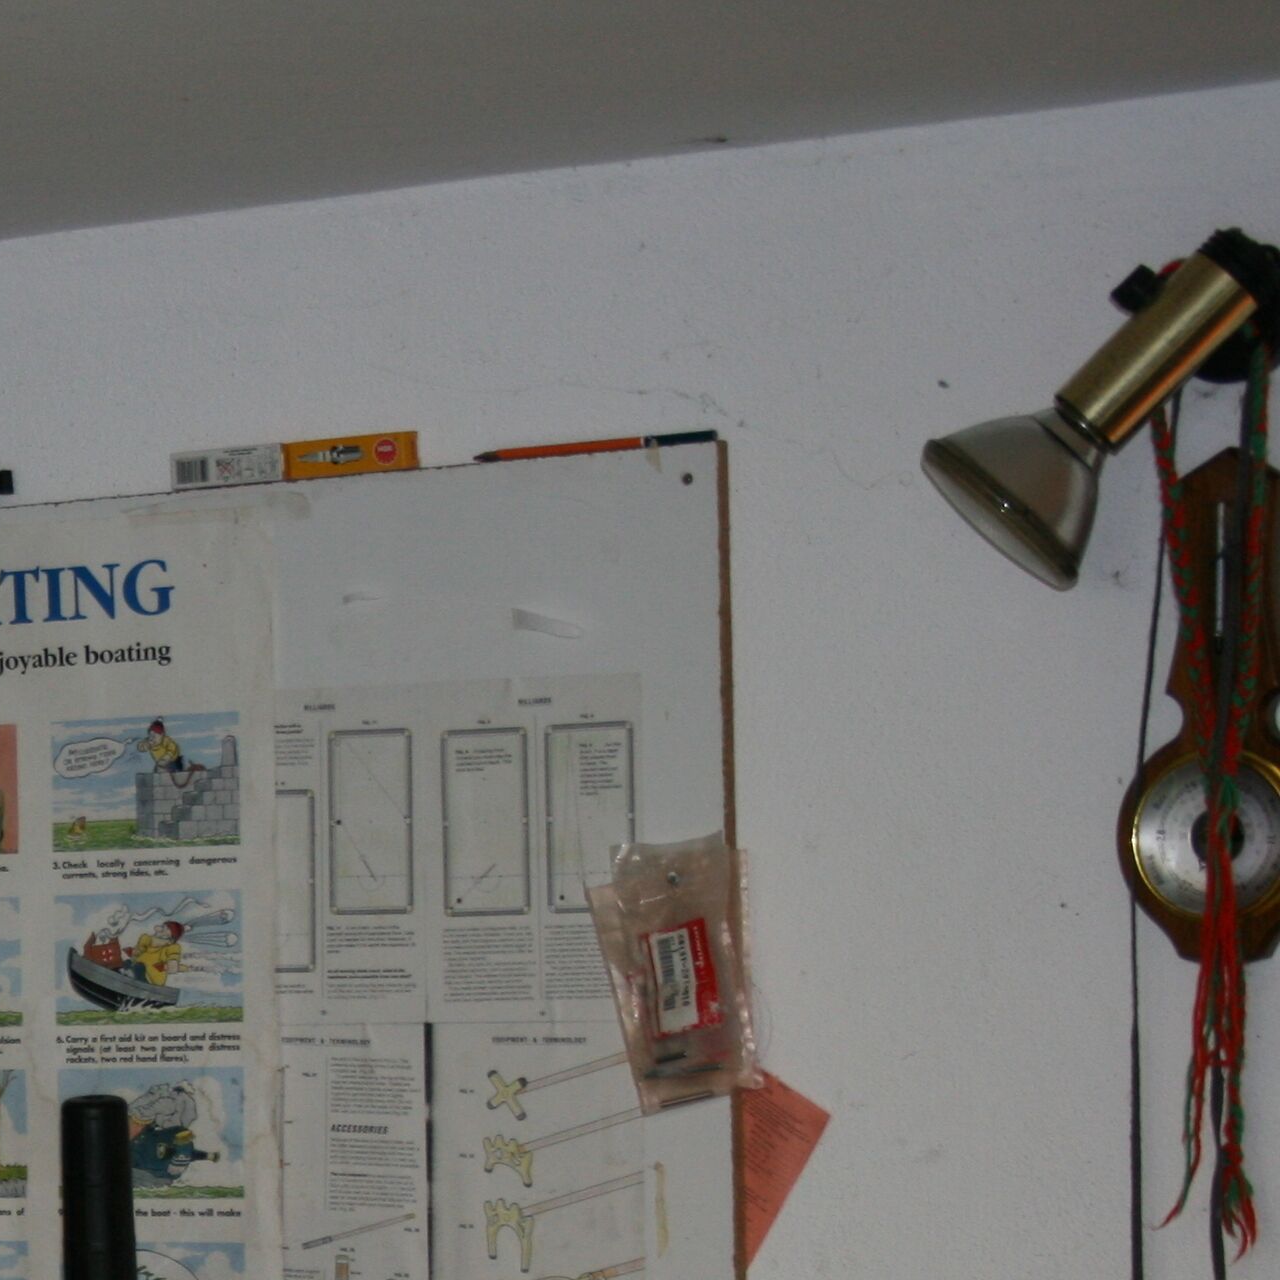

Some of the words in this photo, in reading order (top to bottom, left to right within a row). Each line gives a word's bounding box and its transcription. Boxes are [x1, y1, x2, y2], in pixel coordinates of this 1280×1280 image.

[84, 643, 170, 665] boating
[62, 860, 87, 868] Check
[96, 859, 125, 868] locally
[188, 856, 237, 865] dangerous
[65, 1035, 88, 1044] Carry
[66, 1045, 95, 1055] signals
[160, 1044, 203, 1054] parachute
[208, 1043, 240, 1051] distress
